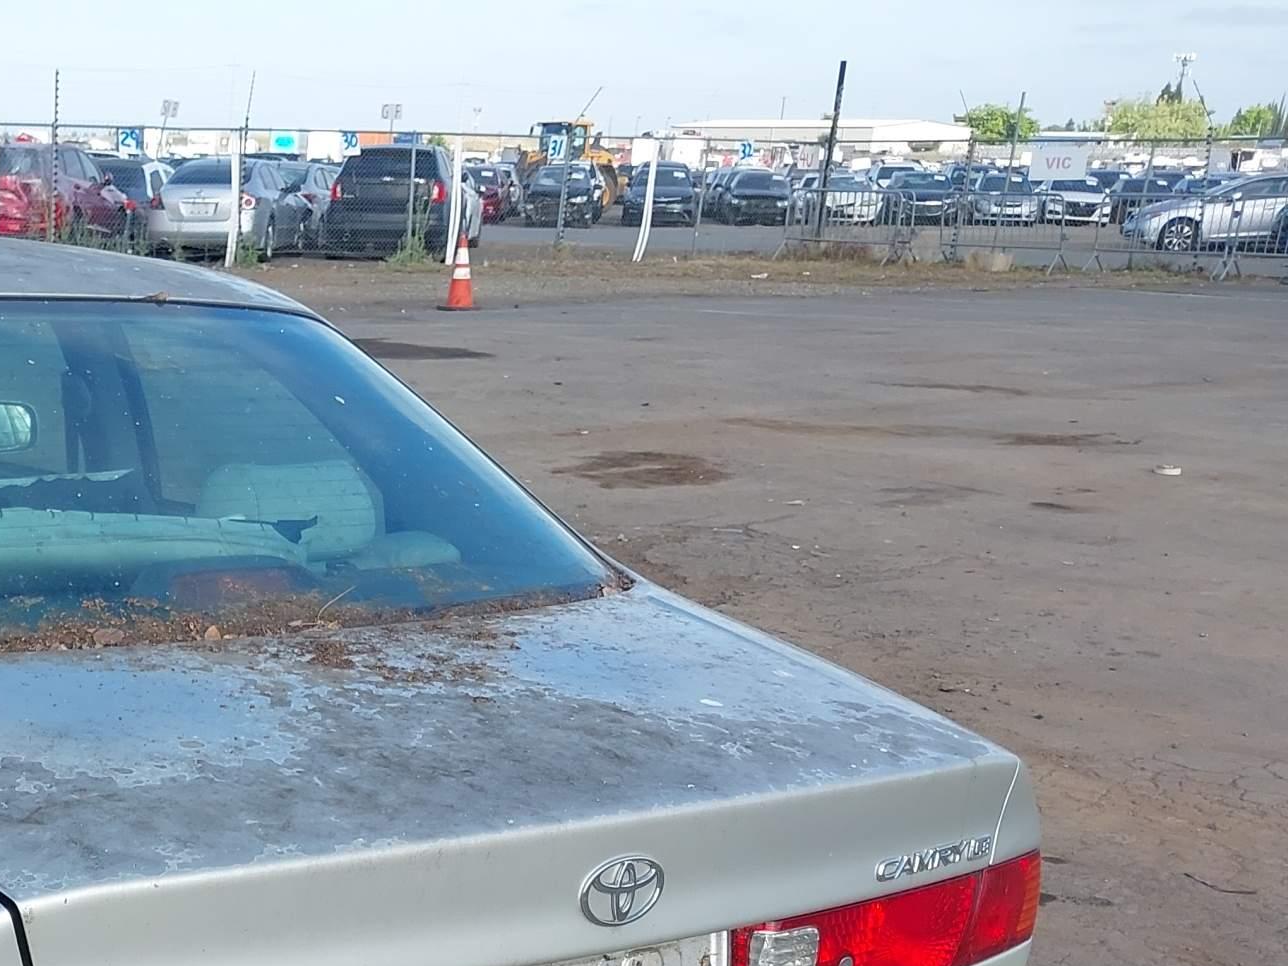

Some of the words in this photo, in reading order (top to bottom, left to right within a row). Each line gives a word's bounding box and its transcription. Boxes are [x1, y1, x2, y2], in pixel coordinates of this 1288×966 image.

[120, 128, 139, 149] 29
[549, 139, 564, 157] 31
[1045, 156, 1072, 170] VIC
[875, 840, 968, 882] CAMRY
